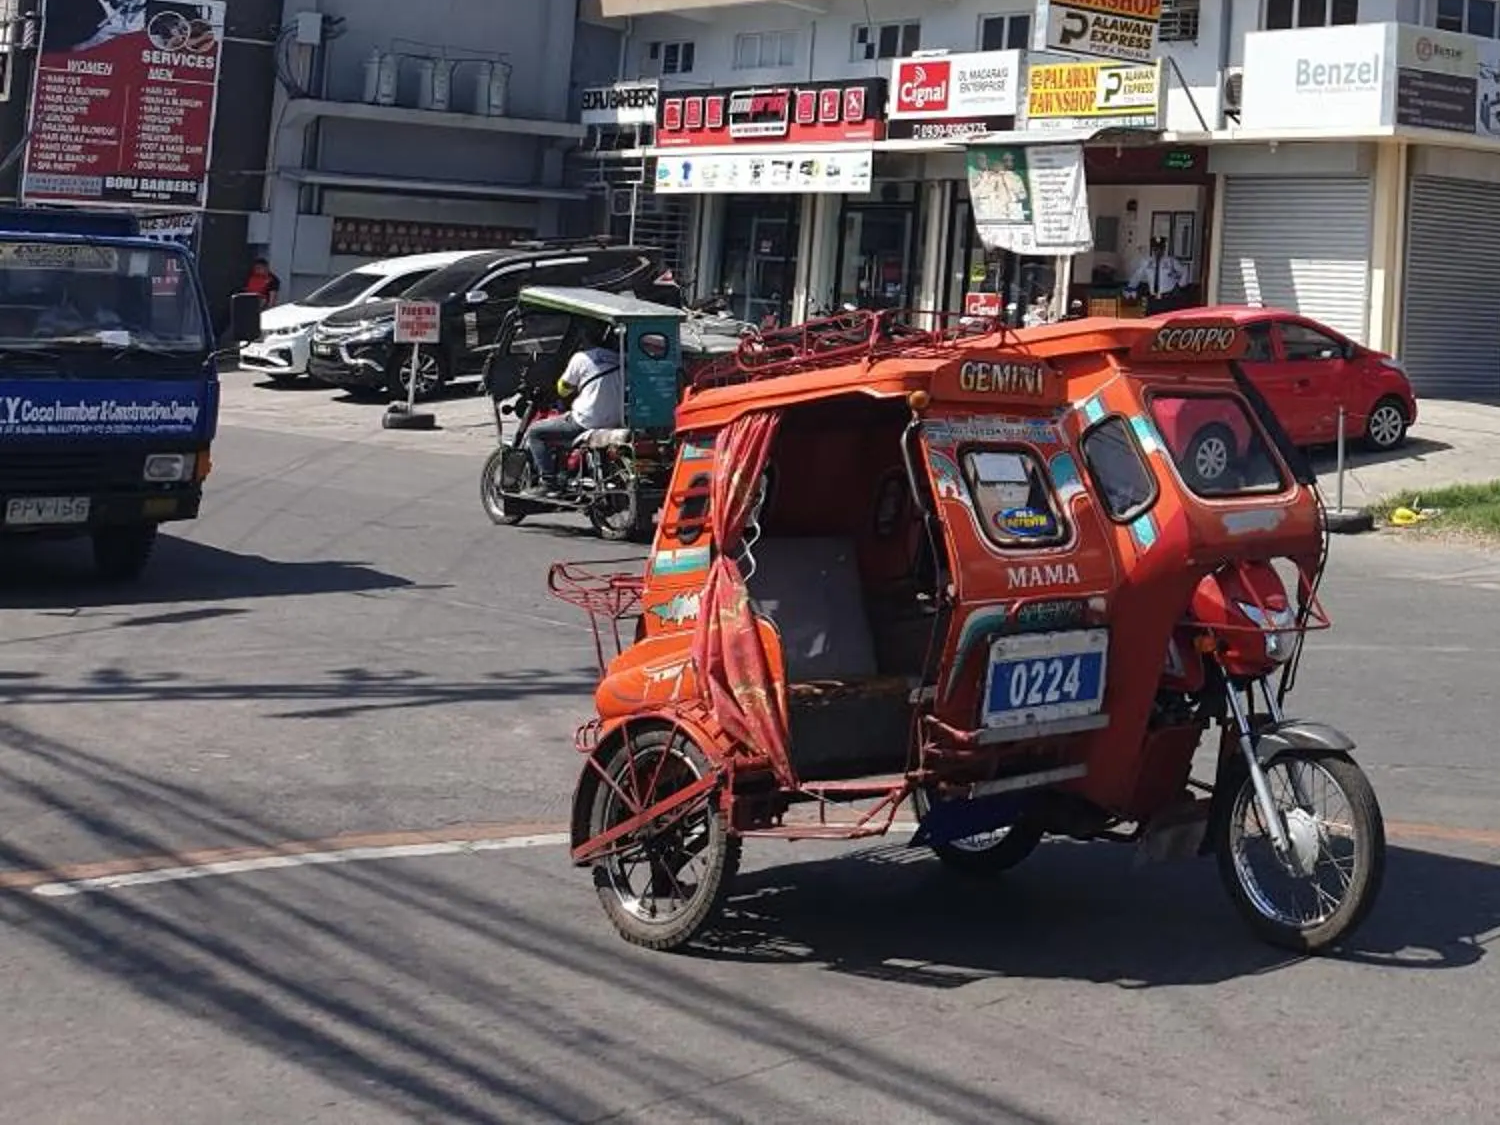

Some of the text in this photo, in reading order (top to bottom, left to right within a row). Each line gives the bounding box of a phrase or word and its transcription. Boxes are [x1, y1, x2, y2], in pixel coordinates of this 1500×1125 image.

[1090, 30, 1152, 51] EXPRESS
[67, 59, 113, 76] WOMEN
[142, 50, 215, 69] SERVICES
[1296, 53, 1379, 86] Benzel
[148, 68, 174, 80] MEN
[1043, 66, 1097, 90] PALAWAN
[901, 79, 947, 108] Cignal
[1029, 88, 1097, 114] PAWNSHOP
[1123, 82, 1154, 95] EXPRESS
[140, 178, 197, 193] BARBERS
[1153, 327, 1237, 353] SCORPIO
[959, 359, 1045, 395] GEMINI
[1007, 563, 1081, 590] MAMA
[1009, 656, 1081, 707] 0224
